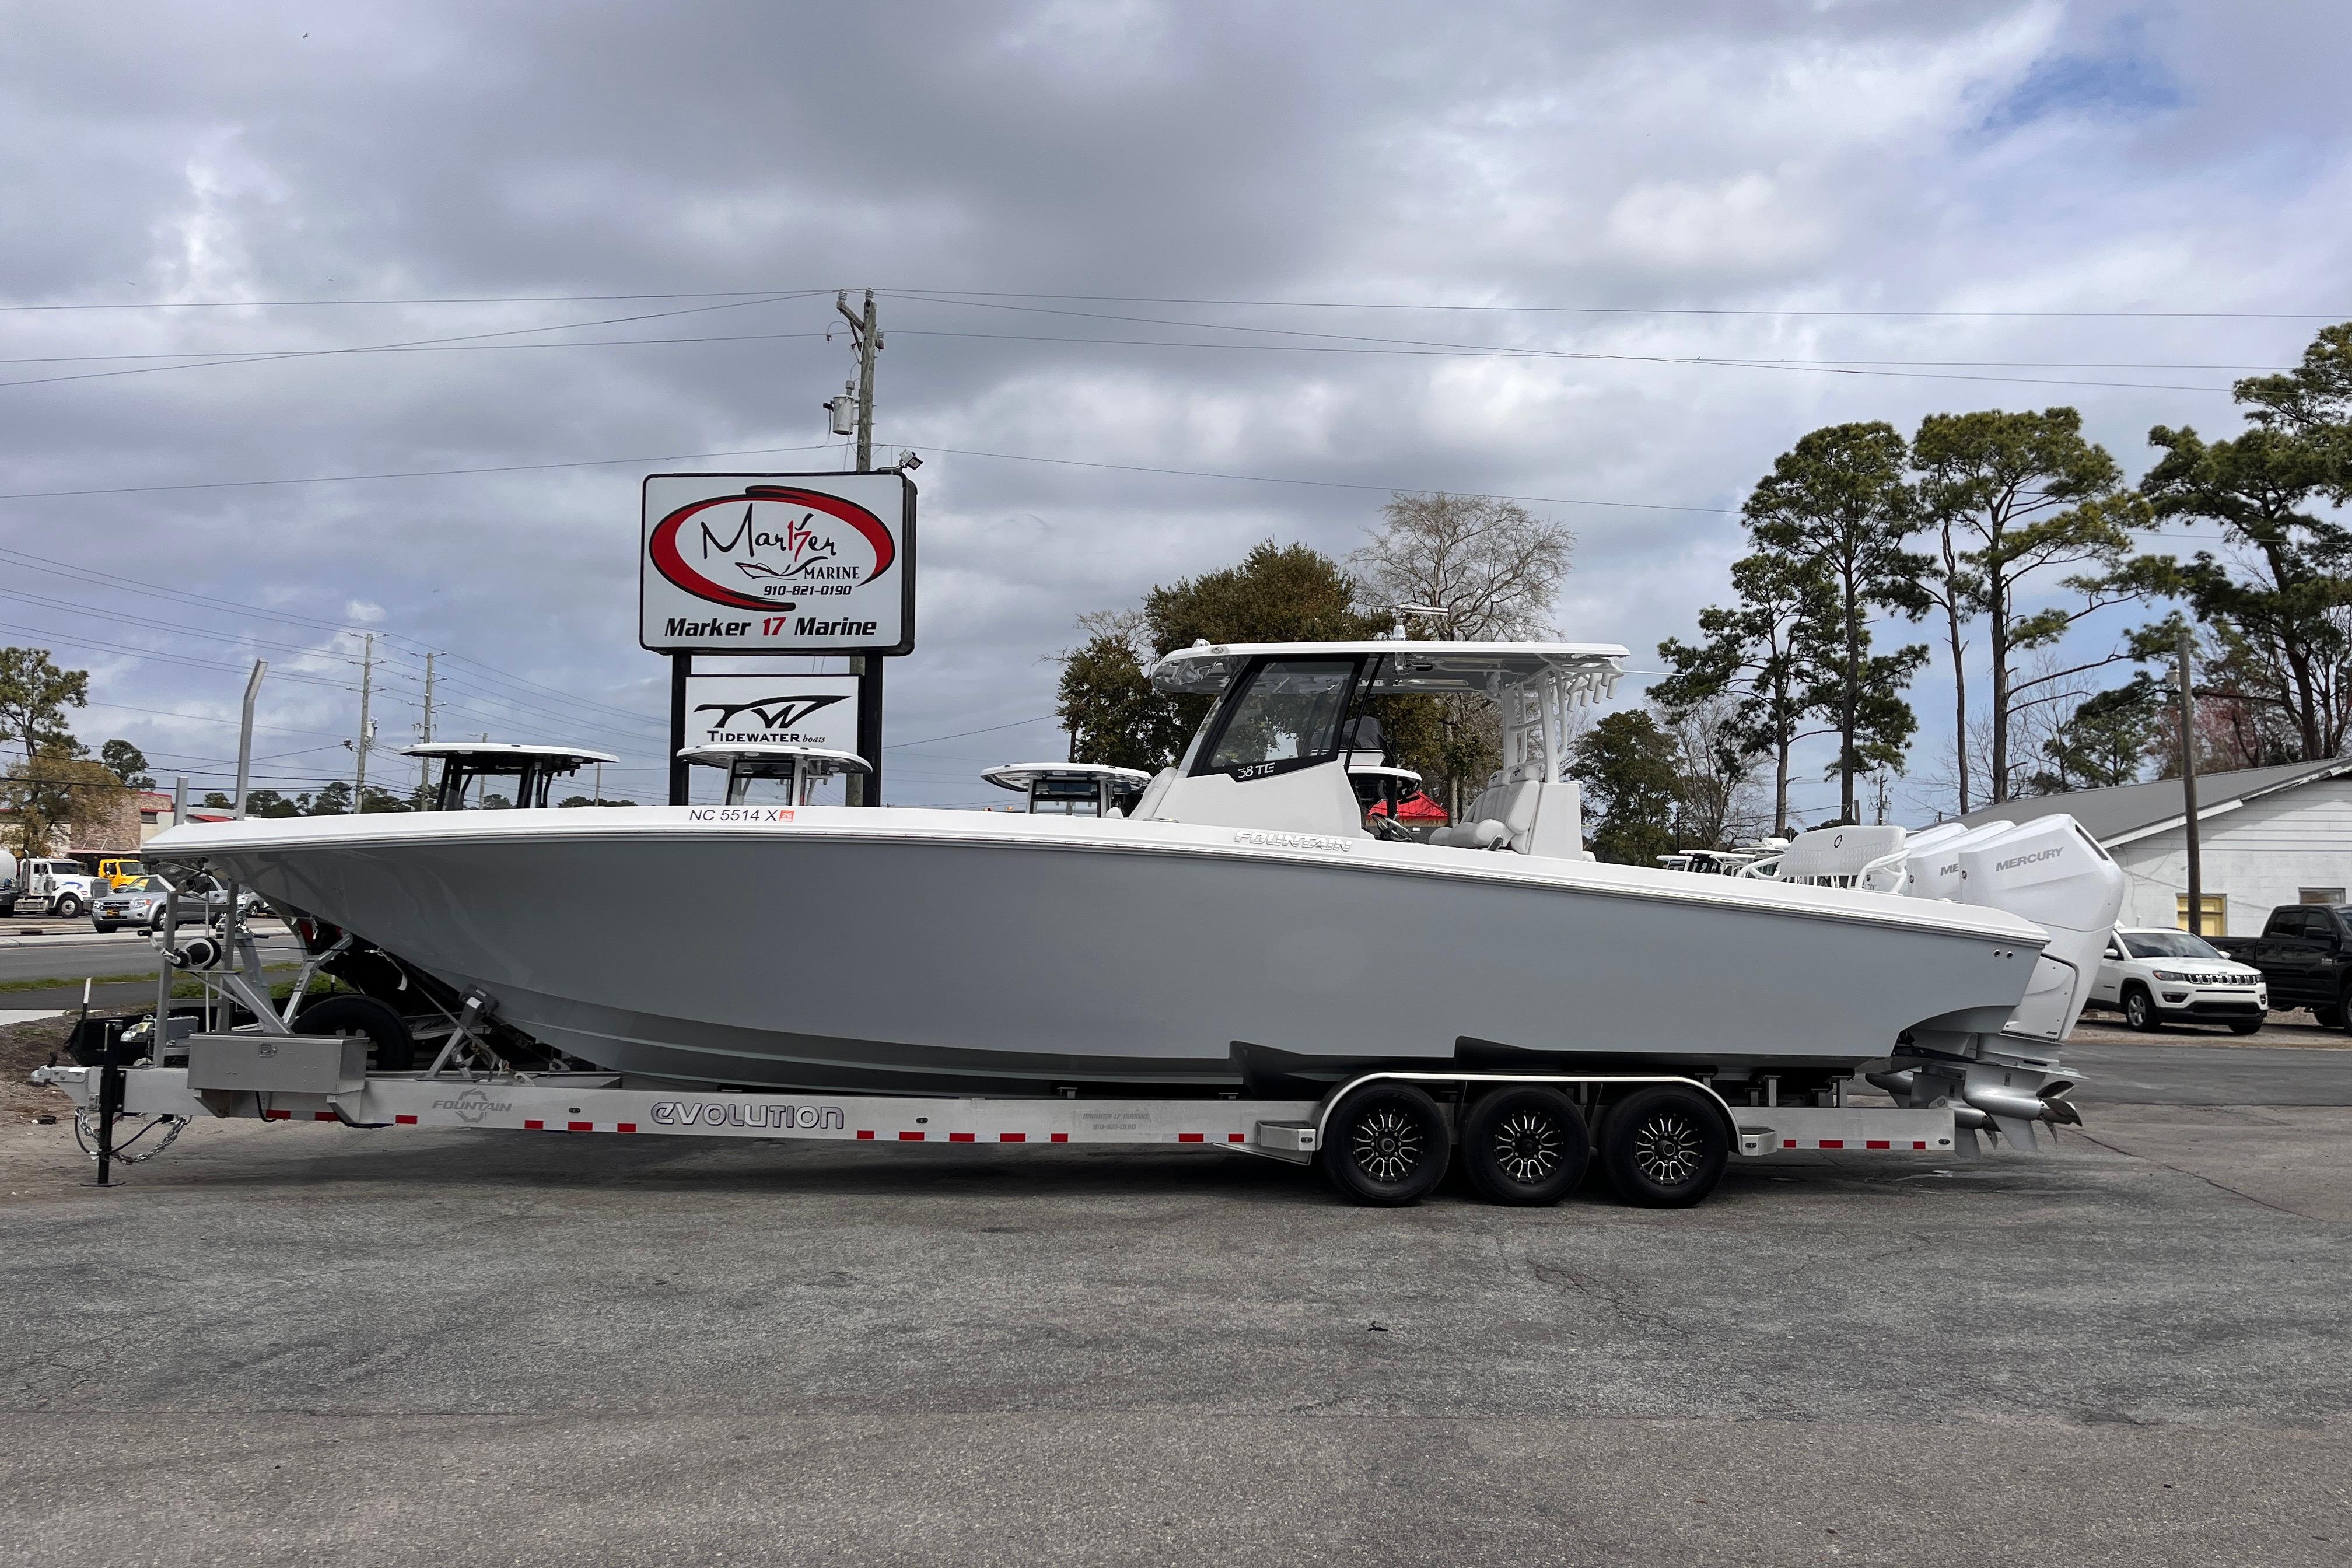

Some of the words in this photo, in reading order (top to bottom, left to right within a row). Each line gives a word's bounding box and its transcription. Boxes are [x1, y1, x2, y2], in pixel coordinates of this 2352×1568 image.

[804, 566, 860, 580] MARINE
[763, 584, 852, 596] 910-821-0190
[664, 617, 751, 637] Marker
[762, 617, 787, 636] 17
[794, 617, 877, 636] Marine
[706, 730, 800, 743] TIDEWATER
[802, 735, 826, 744] boats
[690, 809, 715, 821] NC
[720, 809, 760, 821] 5514
[765, 809, 779, 822] X
[1234, 831, 1352, 852] FOUNTAIN
[1996, 846, 2064, 872] MERCURY
[432, 1100, 512, 1112] FOUNTAIN
